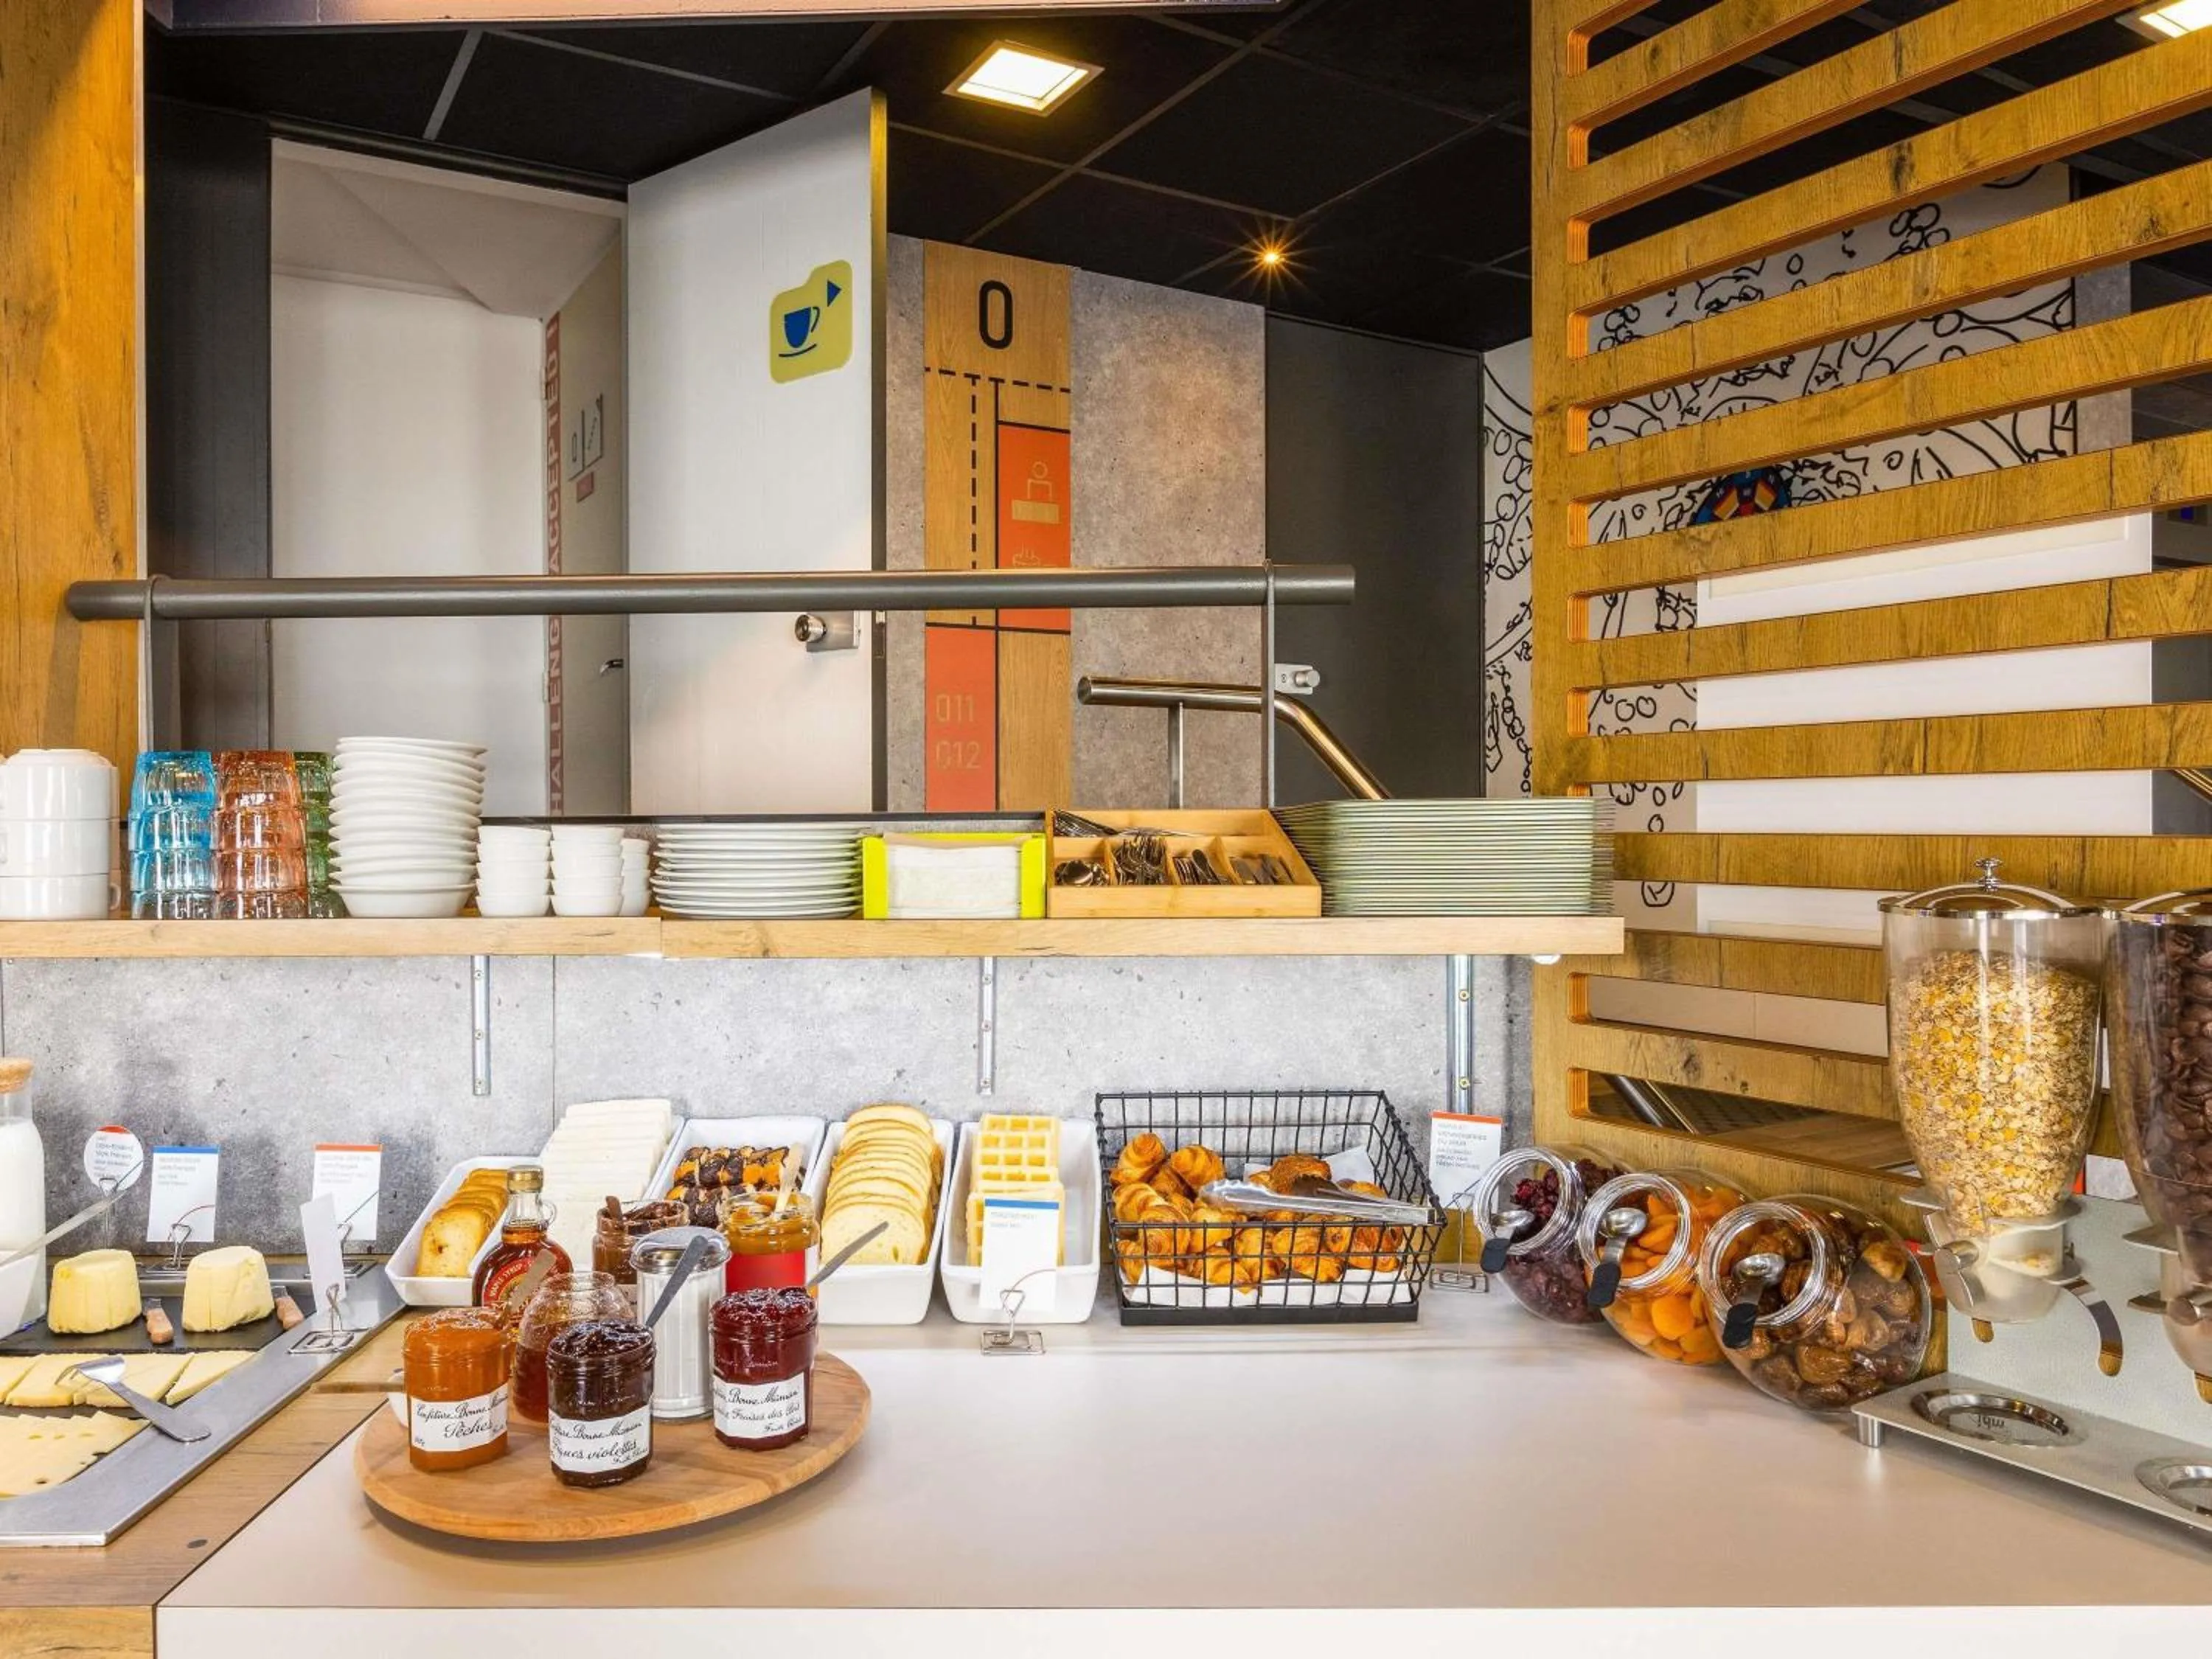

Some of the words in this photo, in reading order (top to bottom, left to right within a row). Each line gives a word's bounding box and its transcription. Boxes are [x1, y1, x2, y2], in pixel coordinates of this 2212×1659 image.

[978, 280, 1013, 349] 0
[548, 349, 560, 575] ACCEPTED
[549, 618, 562, 815] HALLENG
[936, 695, 974, 722] 011
